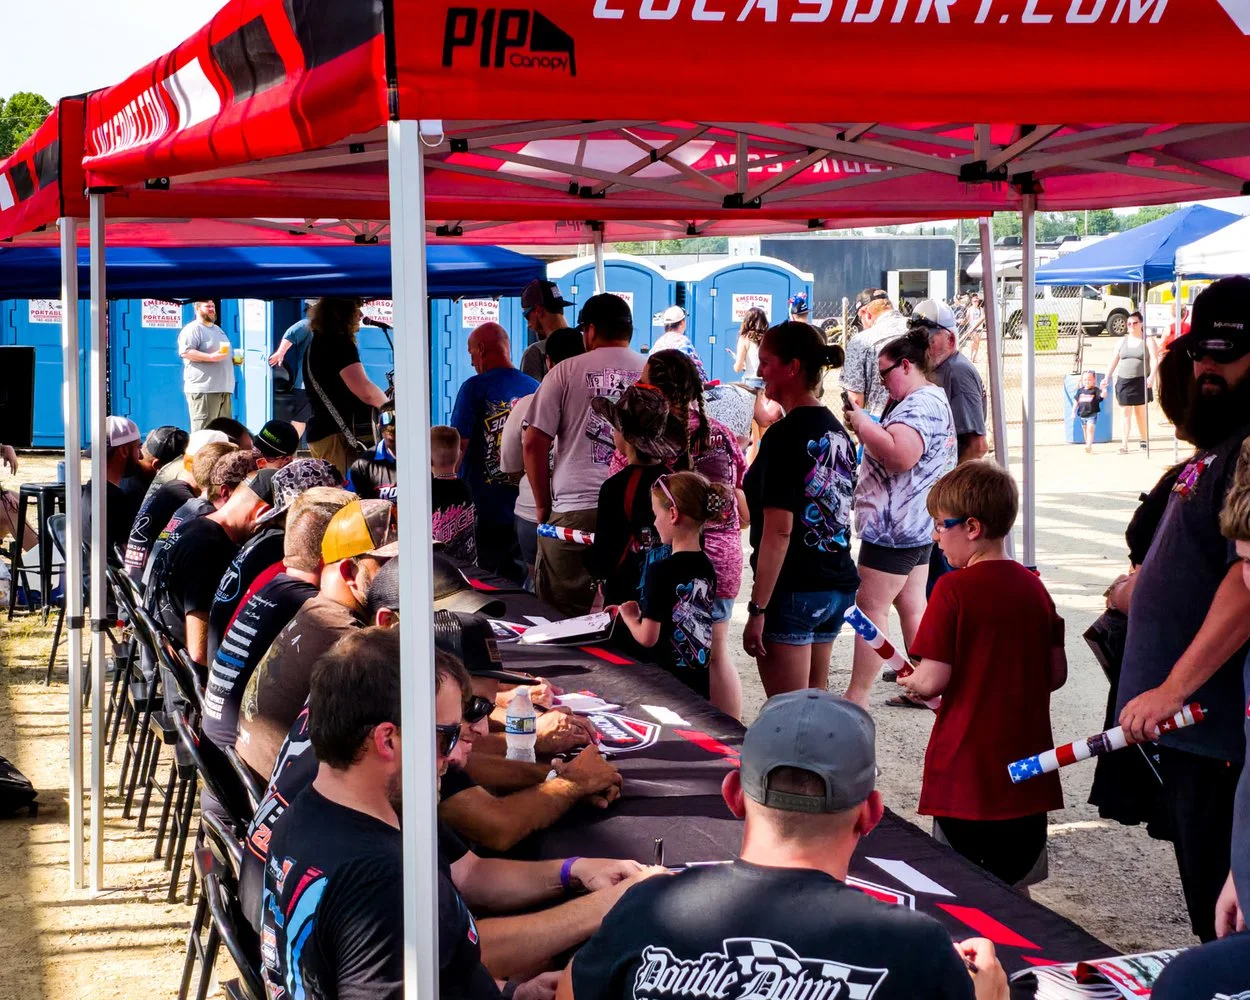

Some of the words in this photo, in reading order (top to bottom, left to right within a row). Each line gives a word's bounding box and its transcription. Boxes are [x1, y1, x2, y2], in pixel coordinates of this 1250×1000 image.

[509, 53, 569, 72] Canopy
[464, 300, 498, 308] EMERSON
[636, 951, 738, 999] Double
